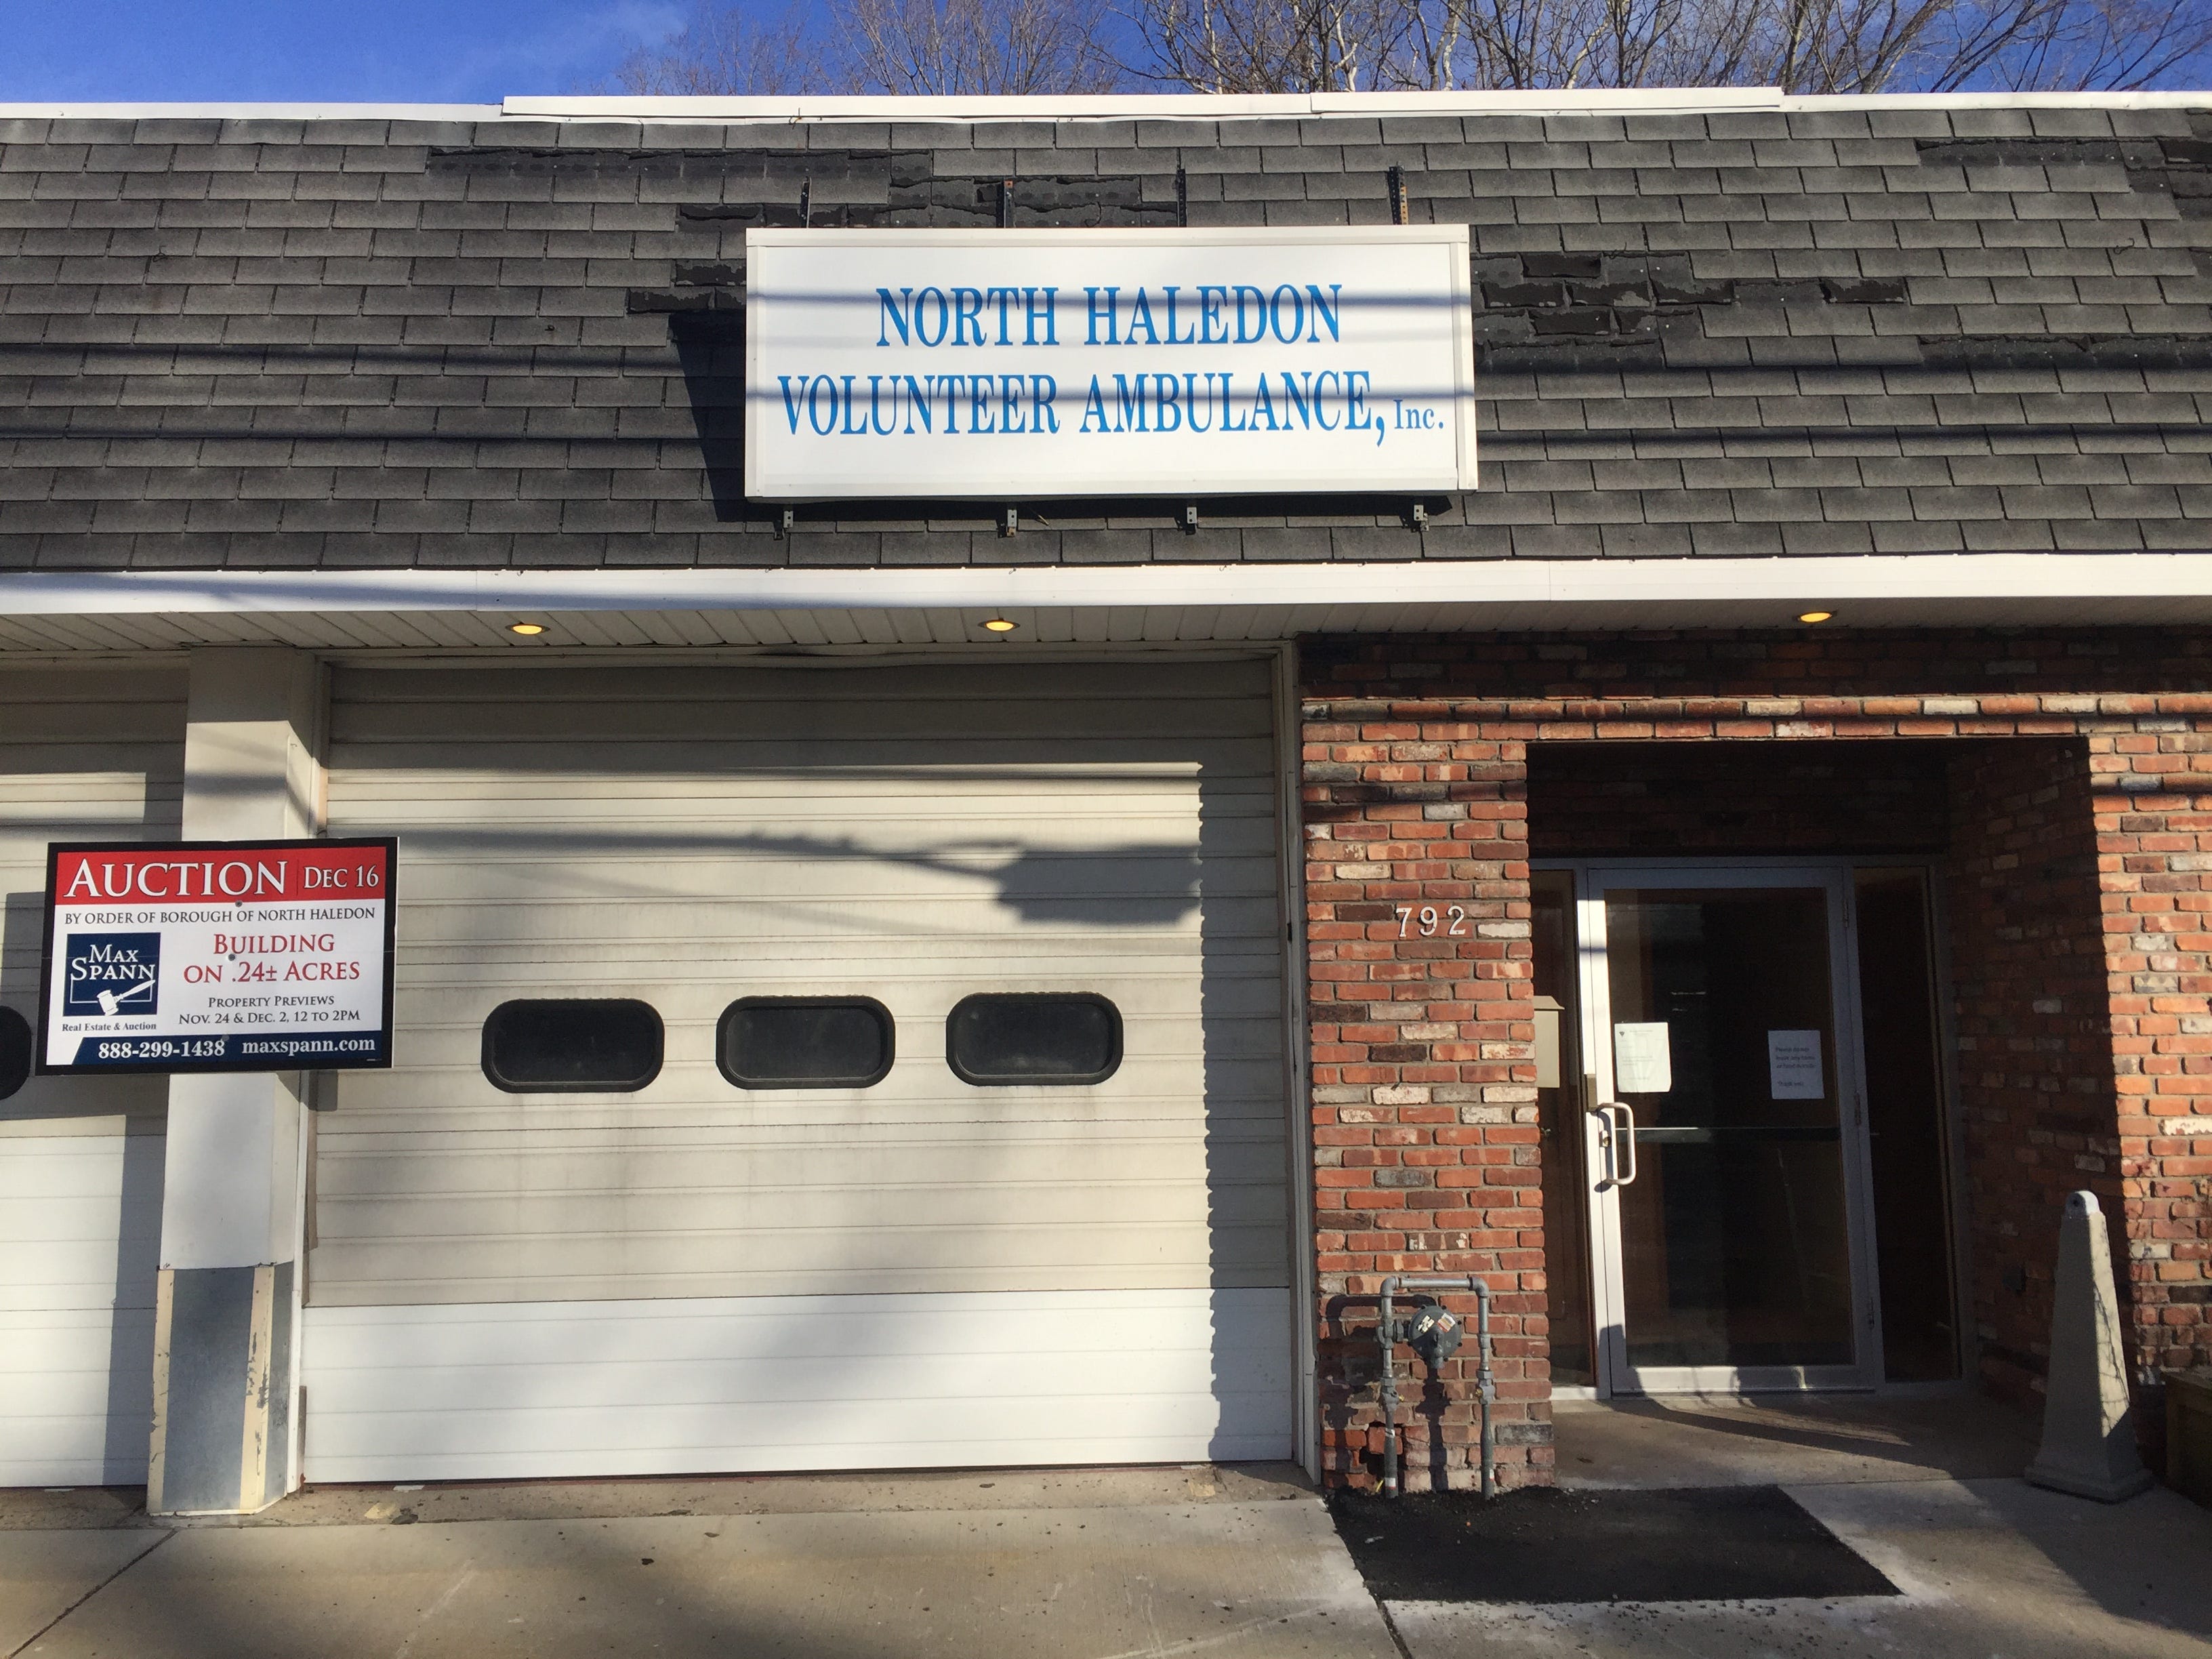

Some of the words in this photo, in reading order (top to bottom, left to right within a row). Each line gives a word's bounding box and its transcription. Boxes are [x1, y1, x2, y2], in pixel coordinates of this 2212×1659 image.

[875, 286, 1060, 348] NORTH
[1083, 283, 1343, 346] HALEDON
[777, 373, 1061, 436] VOLUNTEER
[1078, 369, 1387, 447] AMBULANCE,
[1393, 398, 1444, 430] Inc.
[63, 858, 288, 897] AUCTION
[304, 866, 348, 889] DEC
[356, 864, 380, 888] 16
[64, 913, 81, 925] BY
[84, 912, 135, 924] ORDER
[137, 912, 157, 924] OF
[159, 910, 232, 923] BOROUGH
[236, 909, 255, 922] OF
[257, 908, 306, 922] NORTH
[310, 906, 376, 920] HALEDON
[1395, 905, 1466, 938] 792
[89, 944, 138, 963] MAX
[213, 934, 335, 954] BUILDING
[70, 958, 155, 981] SPANN
[183, 964, 224, 984] ON
[283, 960, 361, 982] ACRES
[207, 996, 271, 1008] PROPERTY
[274, 995, 335, 1007] PREVIEWS
[62, 1022, 82, 1032] Real
[84, 1021, 112, 1031] Estate
[113, 1021, 121, 1031] &
[123, 1021, 157, 1031] Auction
[214, 1012, 230, 1024] 24
[232, 1012, 244, 1024] &
[279, 1010, 290, 1023] 2,
[293, 1010, 308, 1023] 12
[310, 1010, 330, 1022] TO
[332, 1008, 361, 1021] 2PM
[98, 1041, 226, 1059] 888-299-1438
[242, 1038, 375, 1056] maxspann.com
